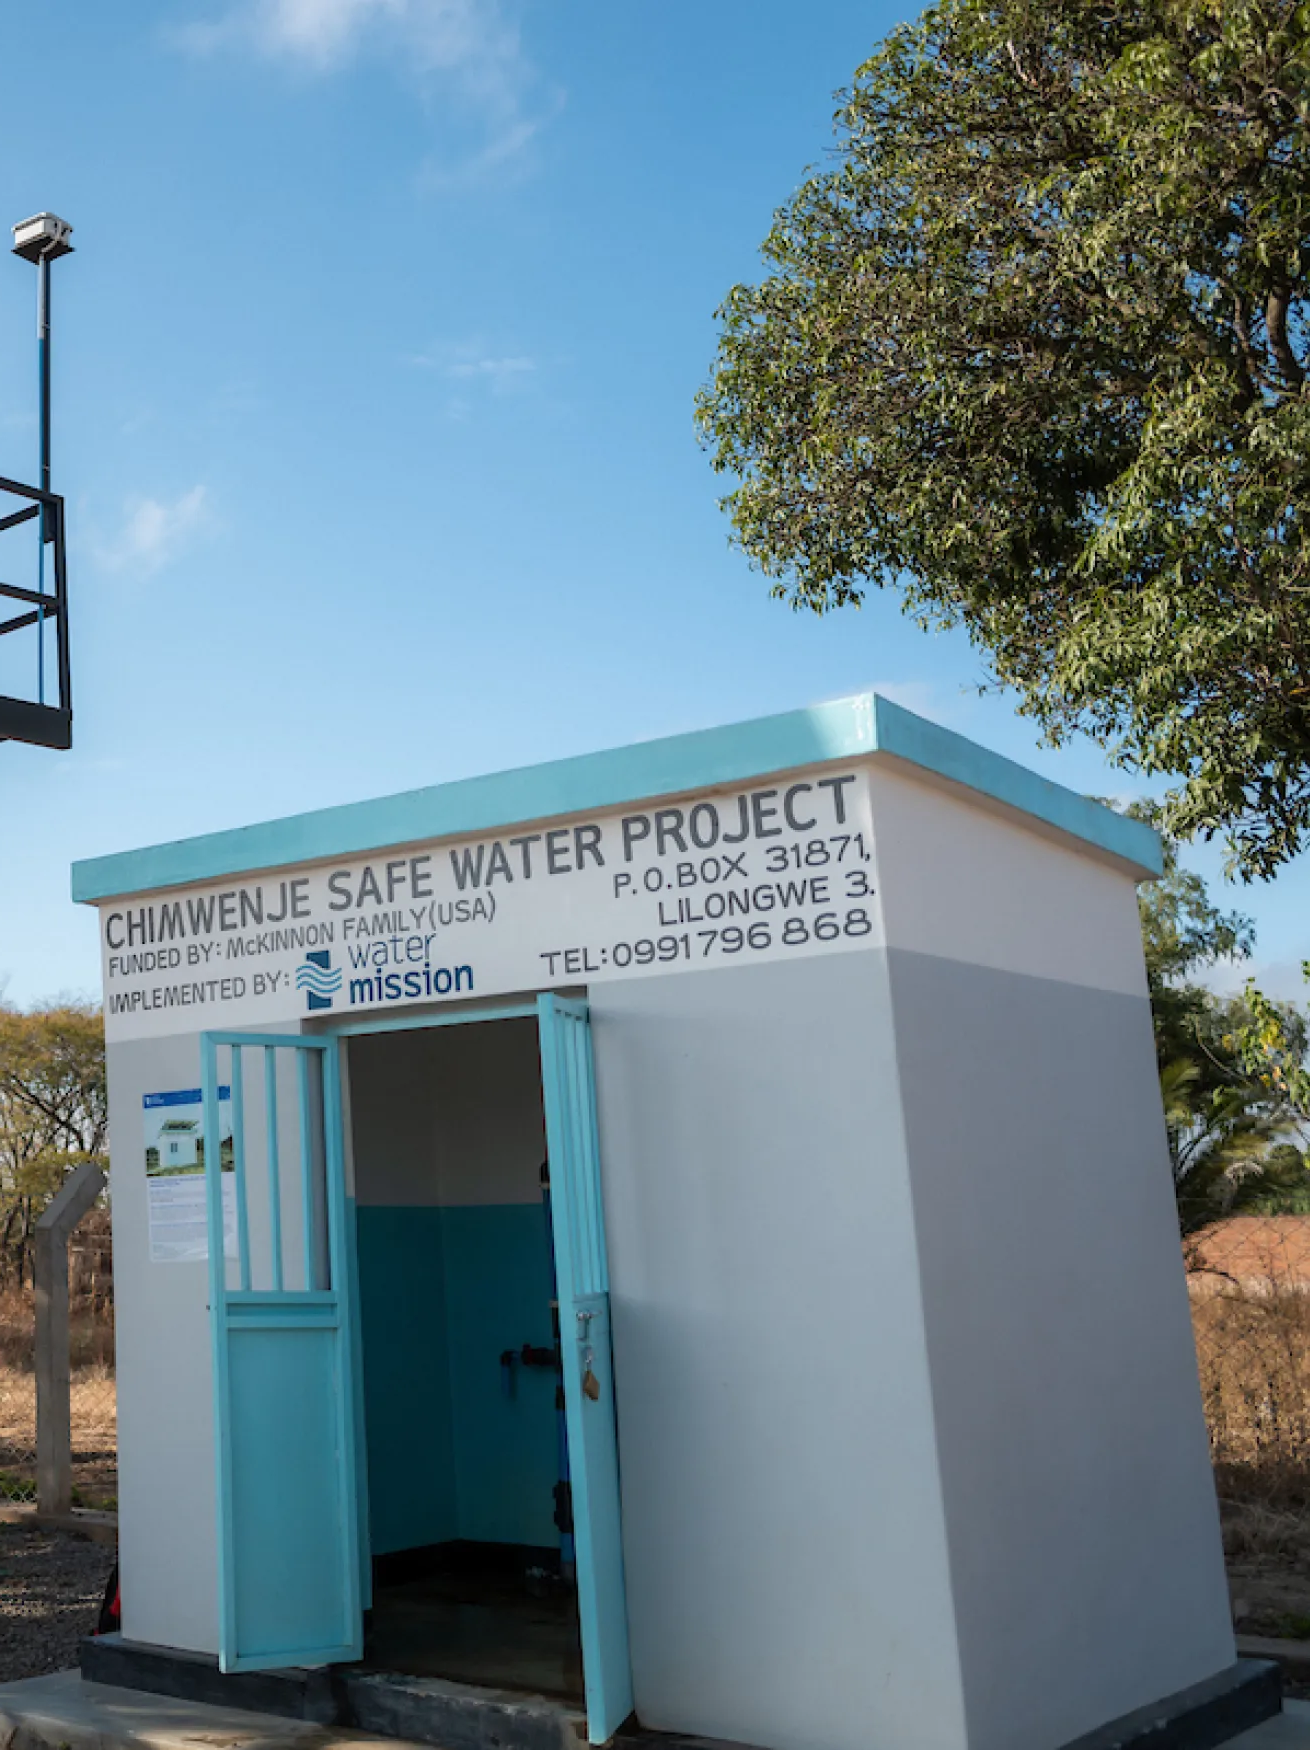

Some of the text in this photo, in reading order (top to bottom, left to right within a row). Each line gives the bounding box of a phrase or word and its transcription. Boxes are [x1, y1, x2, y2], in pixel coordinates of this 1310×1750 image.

[106, 774, 856, 949] CHIMWENJE SAFE WATER PROJECT
[765, 832, 871, 872] 31871,
[658, 876, 830, 926] LILONGWE
[109, 947, 181, 978] FUNDED
[187, 941, 222, 966] BY:
[226, 921, 334, 960] McKINNON
[348, 933, 437, 969] water
[109, 970, 290, 1014] IMPLEMENTED BY:
[349, 961, 474, 1004] mission
